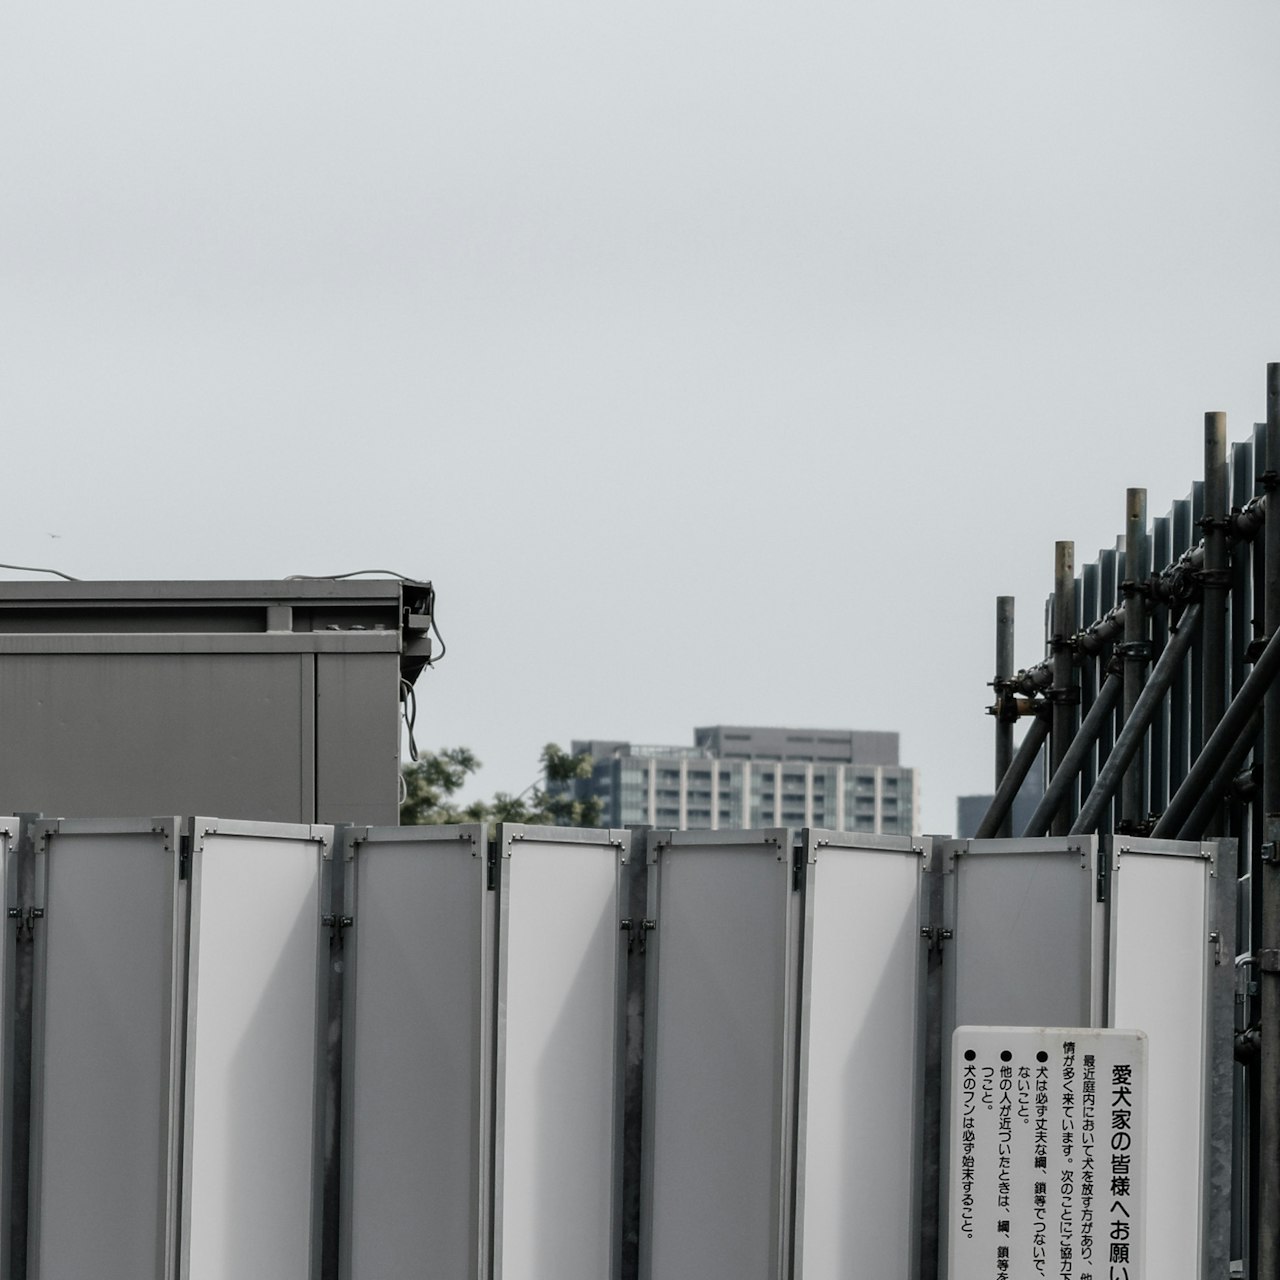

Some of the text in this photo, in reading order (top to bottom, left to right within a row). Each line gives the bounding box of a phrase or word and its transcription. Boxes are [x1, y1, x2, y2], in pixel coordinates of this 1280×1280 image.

[982, 1067, 994, 1110] つこと。
[1018, 1066, 1030, 1124] ないこと。
[961, 1065, 976, 1238] 犬のフンは必ず始末すること。
